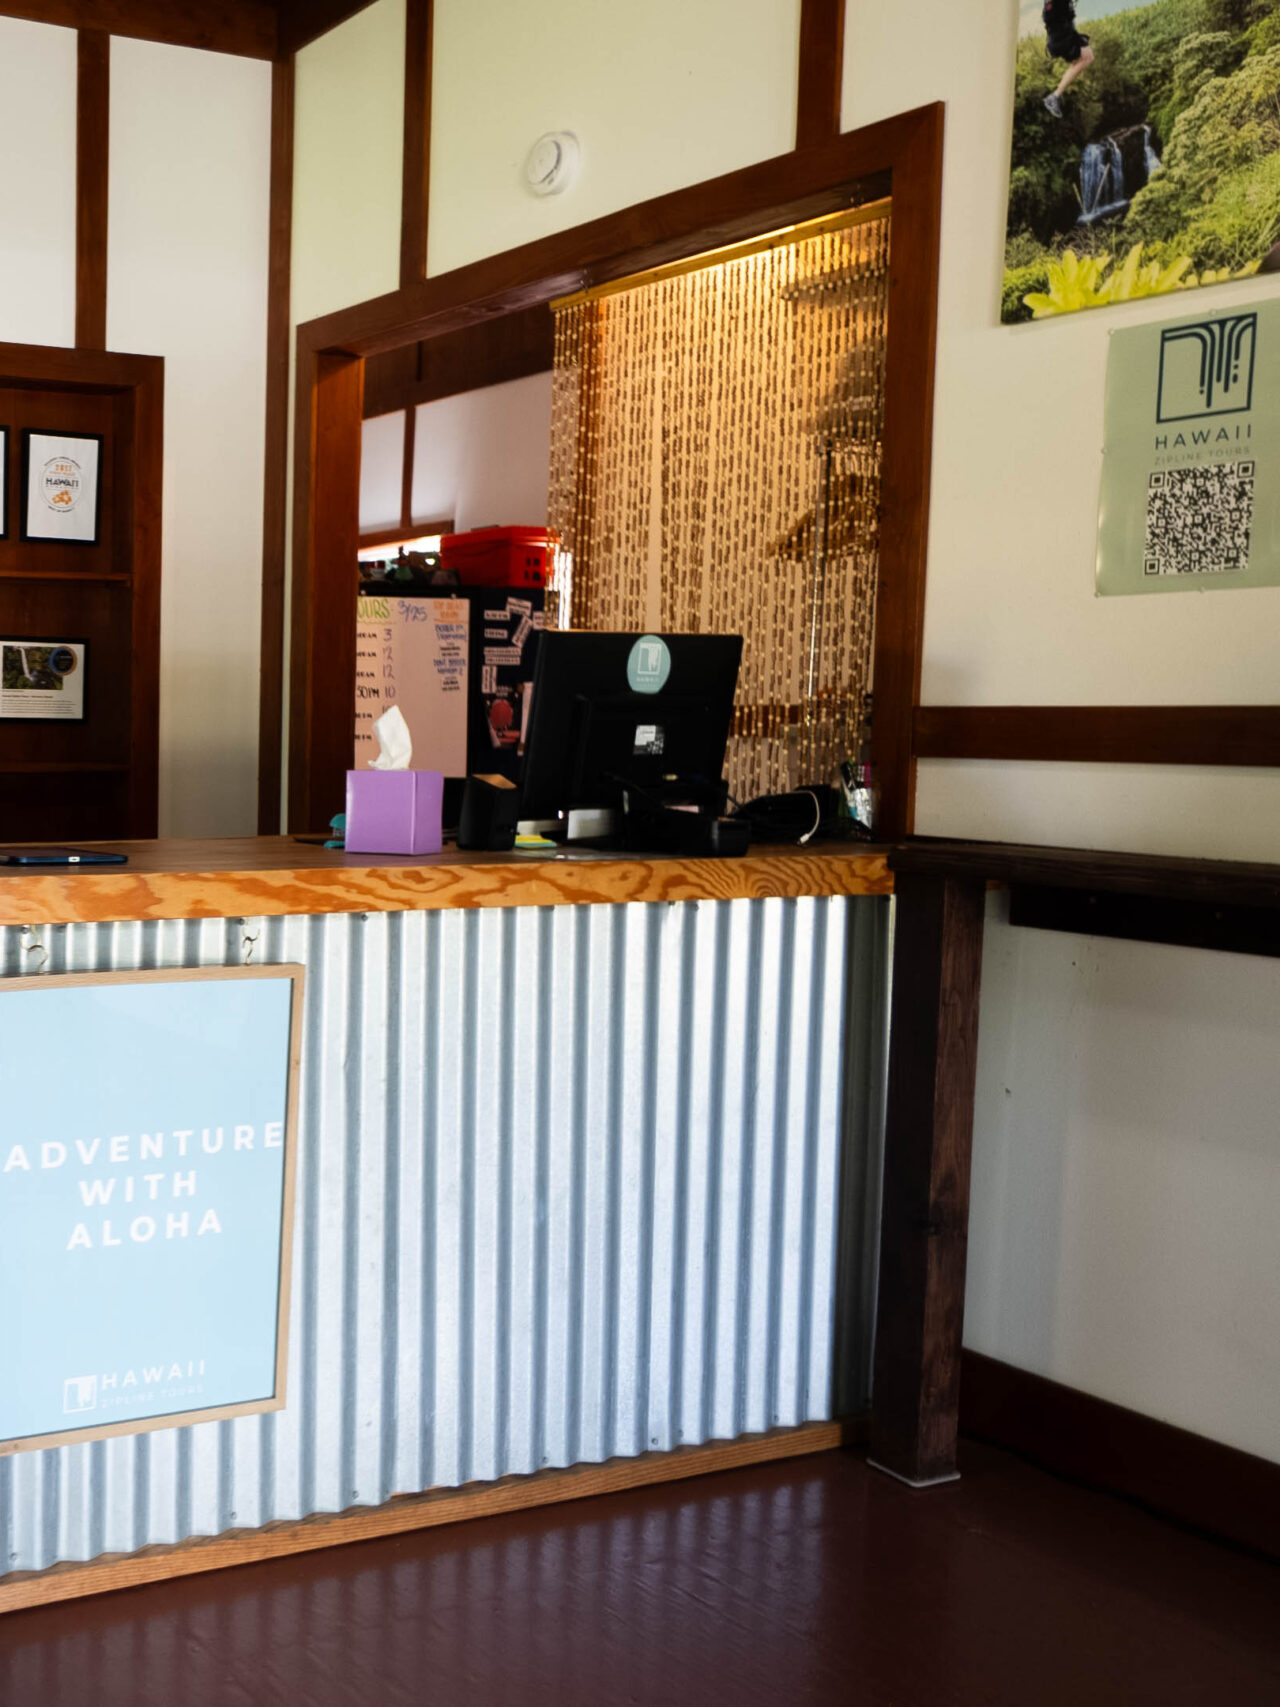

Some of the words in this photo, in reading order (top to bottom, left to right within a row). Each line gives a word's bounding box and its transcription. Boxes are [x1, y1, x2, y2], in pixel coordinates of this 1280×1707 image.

[1155, 423, 1252, 450] HAWAII
[1154, 452, 1201, 466] ZIPLINE
[1208, 446, 1251, 458] TOURS
[383, 628, 392, 642] 3
[382, 664, 394, 680] 12
[3, 1121, 284, 1172] ADVENTURE
[79, 1170, 198, 1207] WITH
[66, 1209, 223, 1250] ALOHA
[102, 1359, 205, 1391] HAWAII
